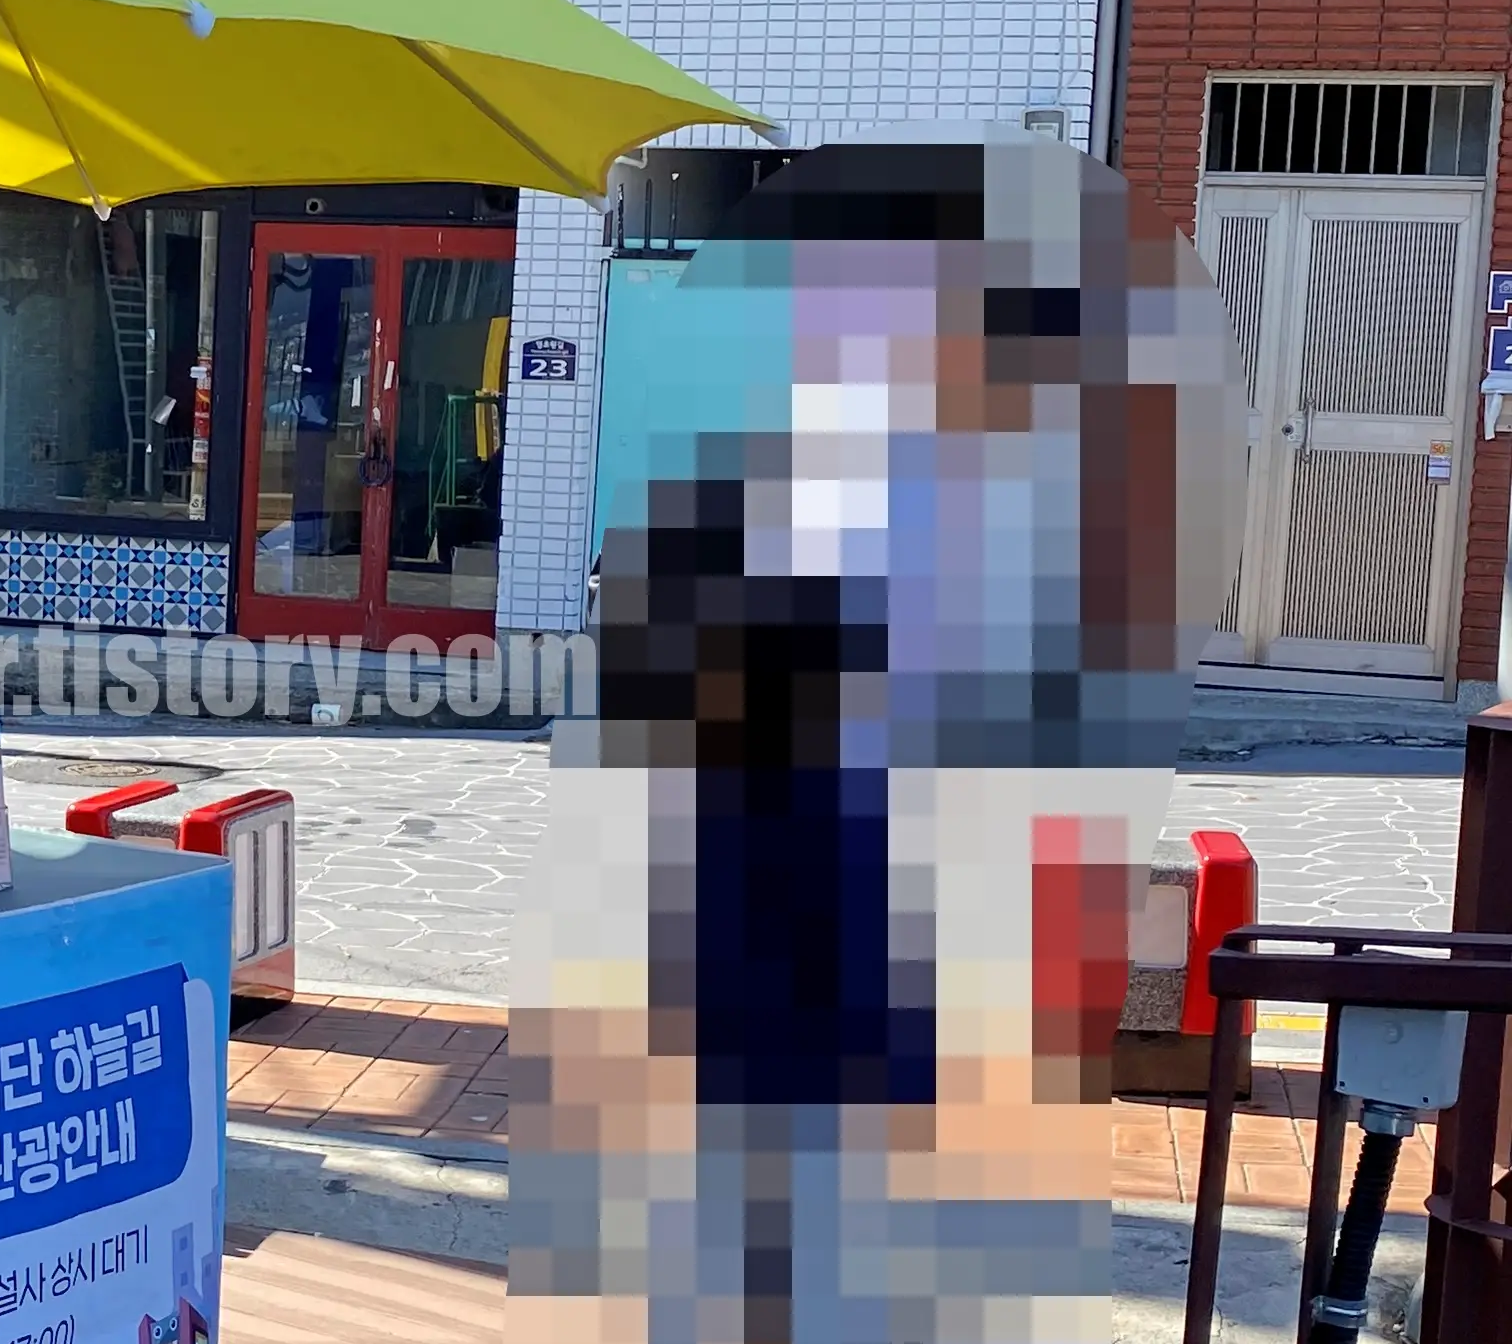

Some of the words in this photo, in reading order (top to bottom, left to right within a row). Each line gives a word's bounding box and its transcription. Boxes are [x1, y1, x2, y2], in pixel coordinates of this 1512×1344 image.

[529, 358, 568, 377] 23
[50, 1004, 163, 1096] 하늘길
[50, 1241, 96, 1298] 상시
[101, 1223, 148, 1276] 대기
